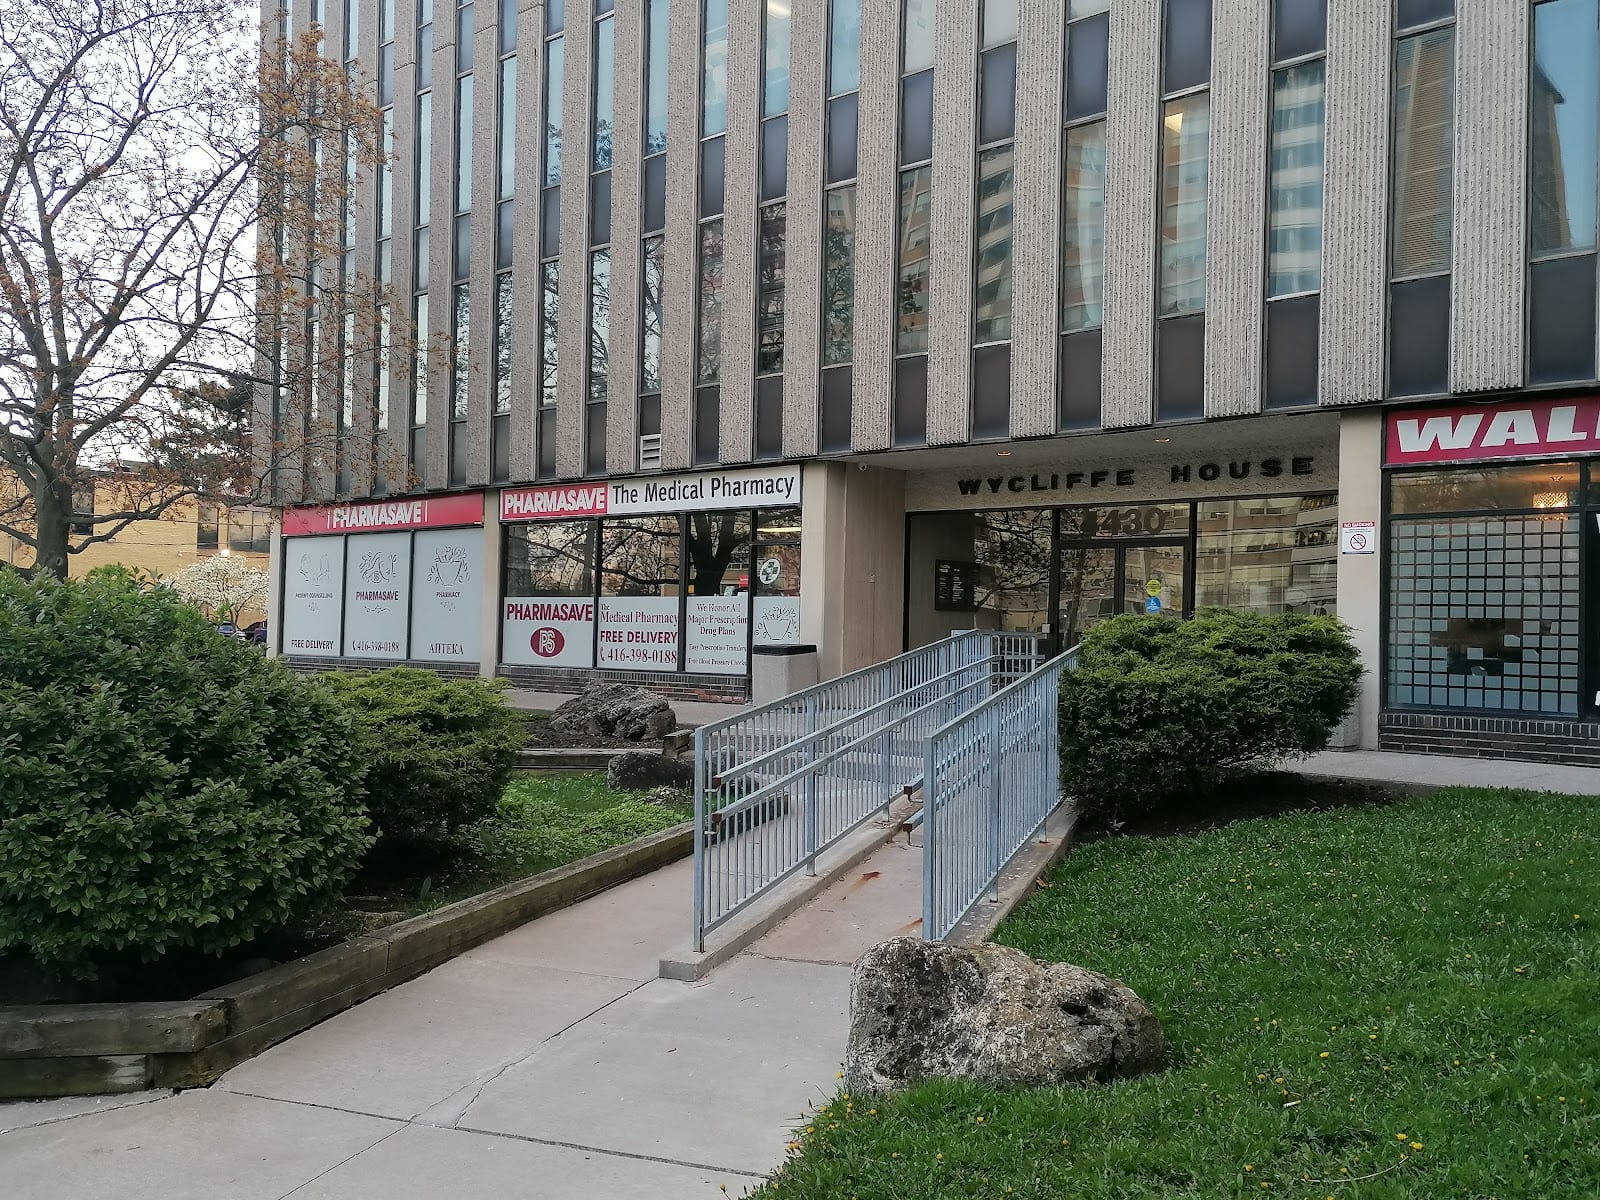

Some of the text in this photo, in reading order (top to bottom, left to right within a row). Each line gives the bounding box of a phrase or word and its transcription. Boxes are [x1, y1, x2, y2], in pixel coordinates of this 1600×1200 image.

[1396, 405, 1600, 453] WAL
[957, 455, 1315, 496] WYCLIFFE HOUSE
[503, 476, 795, 514] PHARMASAVE The Medical Pharmacy
[332, 500, 422, 529] PHARMASAVE
[1079, 508, 1166, 535] 1430
[355, 590, 399, 601] PHARMASAVE
[506, 603, 593, 622] PHARMASAVE
[601, 603, 610, 611] The
[600, 611, 679, 627] Medical Pharmacy
[688, 614, 709, 626] Major
[600, 630, 678, 644] FREE DELIVERY
[700, 626, 736, 637] Drug Plans
[290, 639, 334, 650] FREE DELIVERY
[357, 640, 400, 653] 416-398-0188
[539, 629, 556, 654] PS
[607, 647, 677, 664] 416-398-0188
